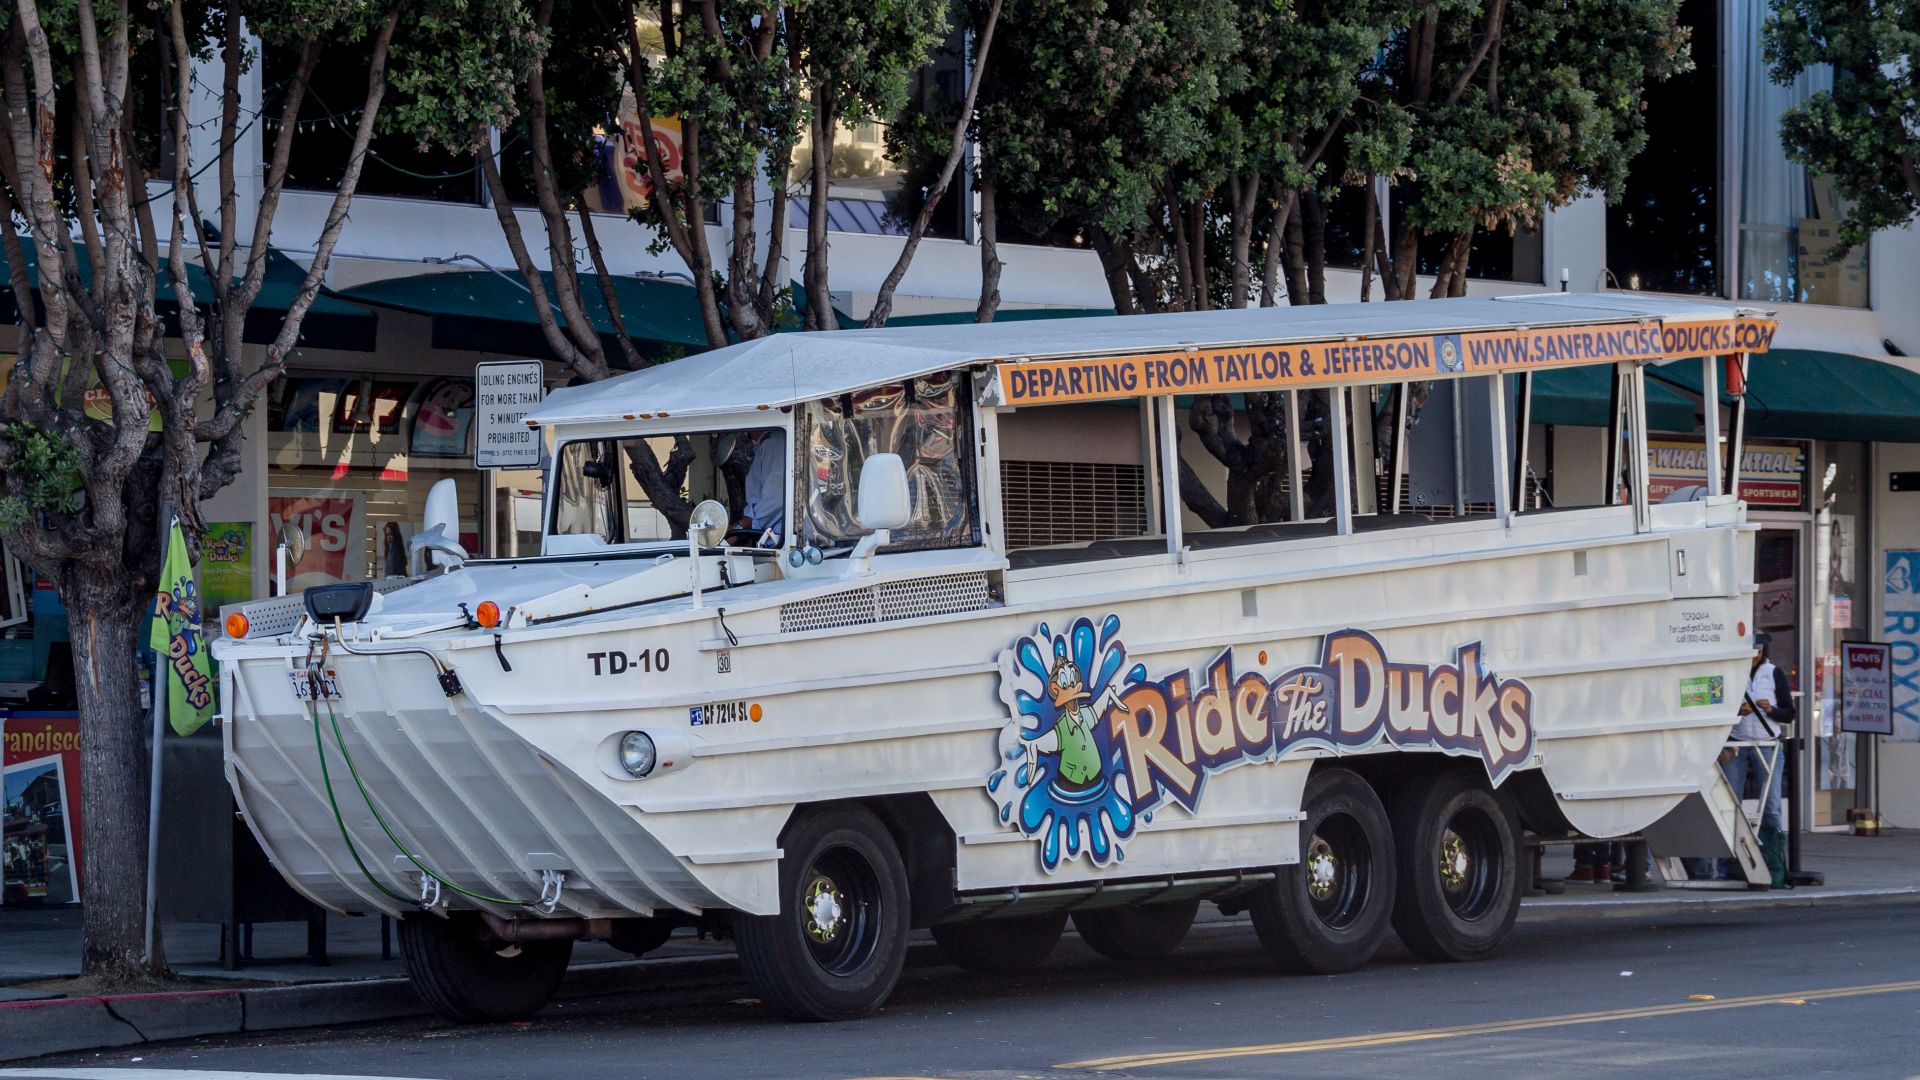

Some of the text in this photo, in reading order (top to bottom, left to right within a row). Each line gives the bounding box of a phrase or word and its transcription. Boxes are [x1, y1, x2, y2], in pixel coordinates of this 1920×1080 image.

[1468, 322, 1774, 366] WWW.SANFRANCISCODUCKS.COM
[481, 373, 538, 387] IDLING ENGINES
[1011, 340, 1430, 399] DEPARTING FROM TAYLOR & JEFFERSON
[481, 392, 538, 406] FOR MORE THAN
[490, 414, 495, 425] 5
[488, 431, 530, 444] PROHIBITED
[1656, 447, 1708, 469] WHAR
[1743, 488, 1798, 498] SPORTSWEAR
[168, 634, 211, 710] Ducks
[587, 648, 670, 676] TD-10
[719, 656, 730, 672] 30
[1884, 610, 1920, 724] ROXY
[1847, 687, 1885, 699] SPECIAL
[704, 702, 749, 725] CF 7214 SL
[1107, 650, 1274, 807] Ride
[1327, 630, 1531, 774] Ducks
